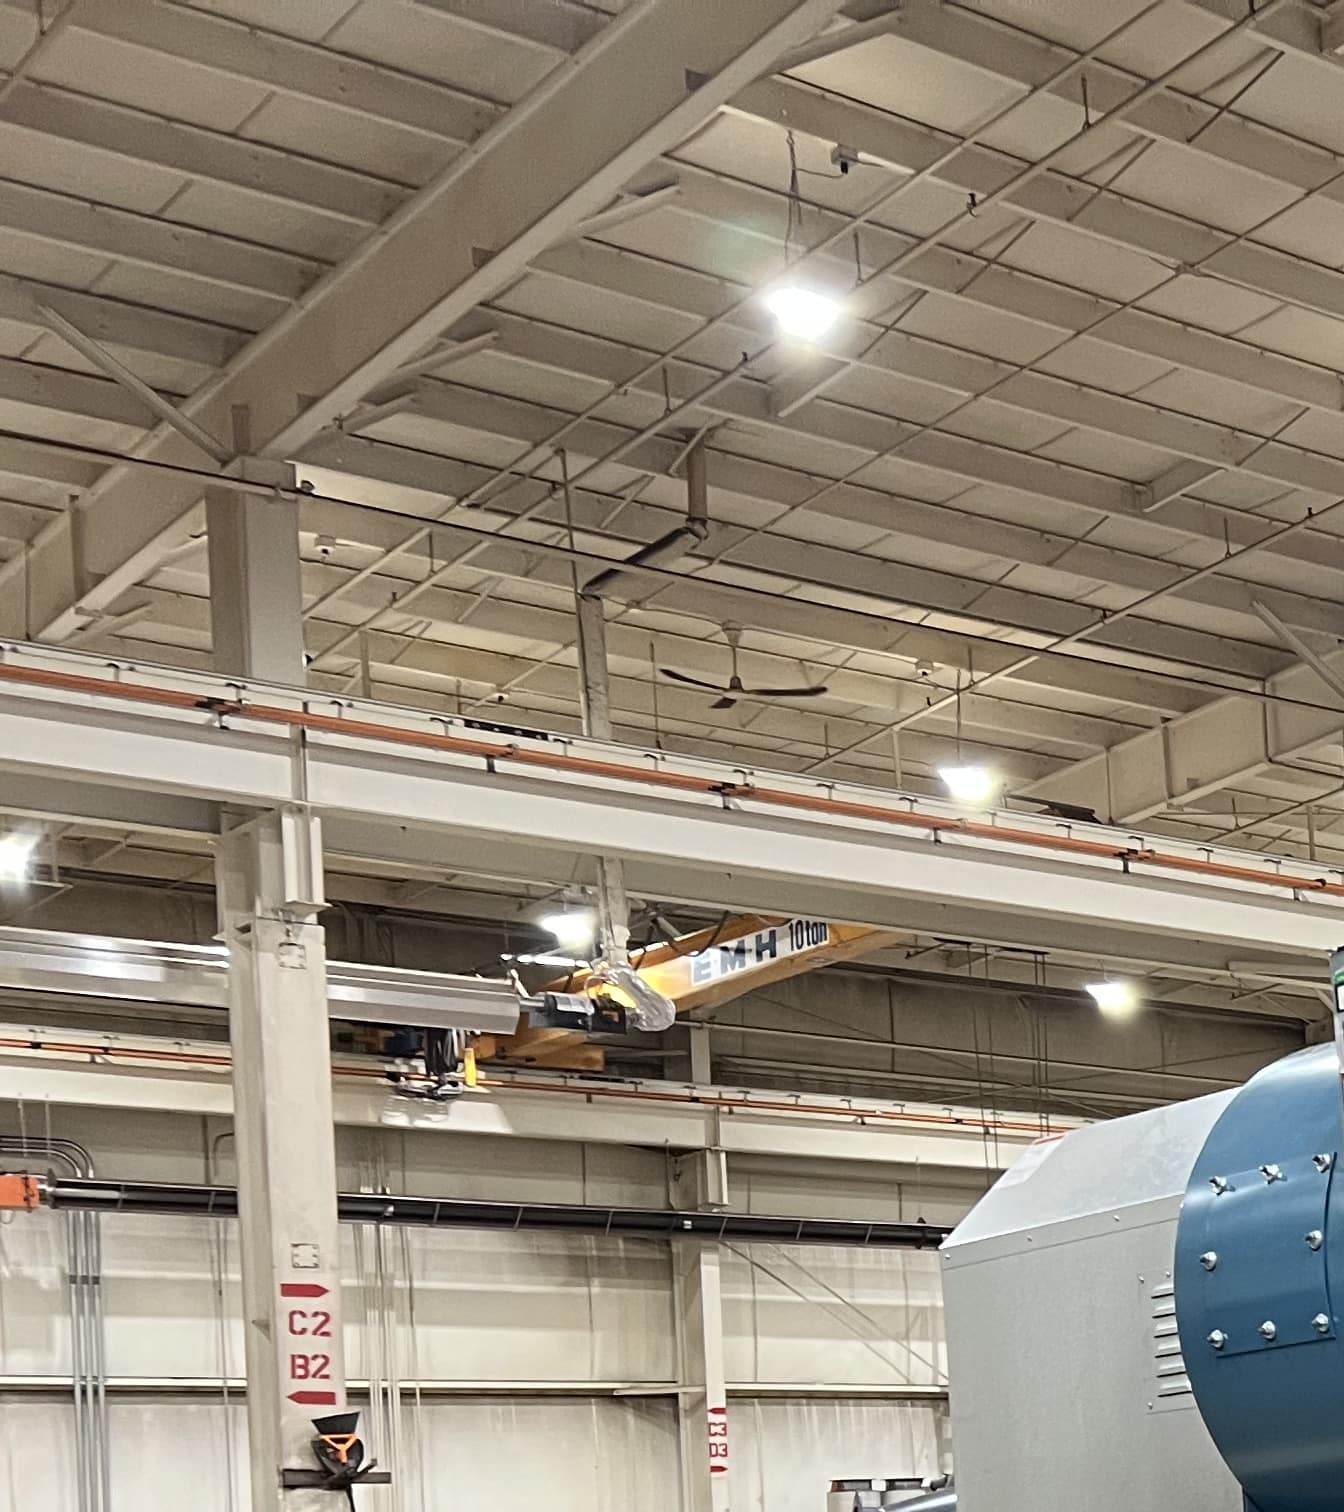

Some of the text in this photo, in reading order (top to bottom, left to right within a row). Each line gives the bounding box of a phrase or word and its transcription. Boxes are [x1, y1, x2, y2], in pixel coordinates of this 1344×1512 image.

[694, 929, 777, 983] EMH
[289, 1310, 331, 1337] C2
[290, 1354, 330, 1379] B2
[709, 1443, 728, 1457] D3
